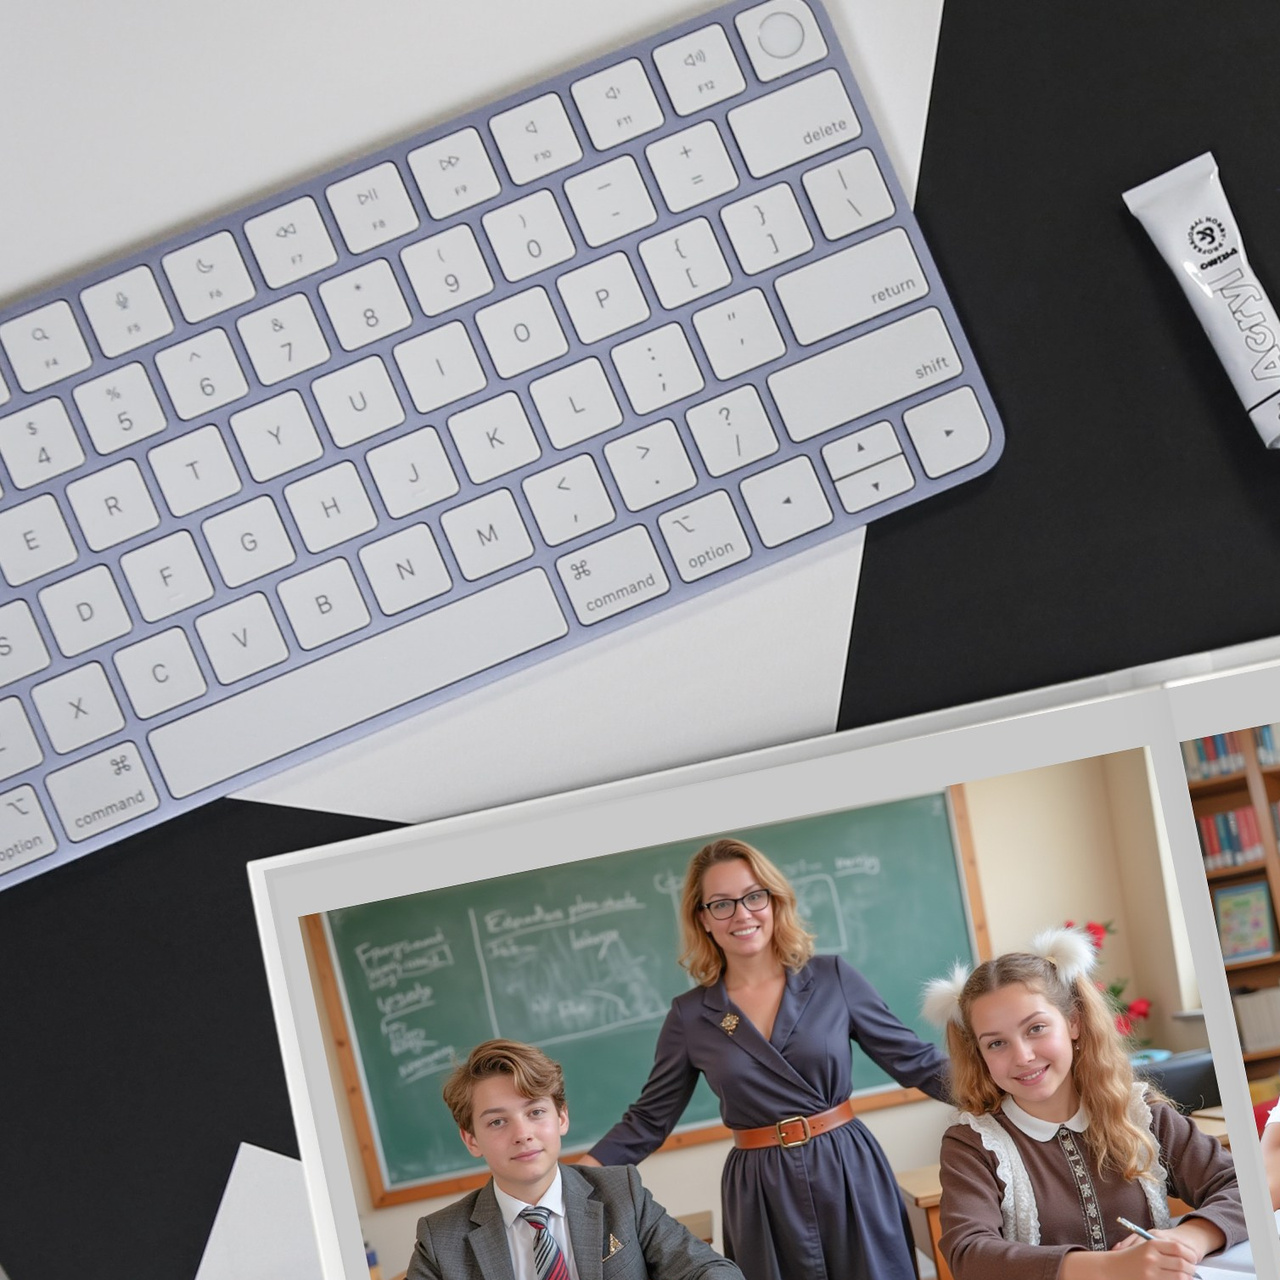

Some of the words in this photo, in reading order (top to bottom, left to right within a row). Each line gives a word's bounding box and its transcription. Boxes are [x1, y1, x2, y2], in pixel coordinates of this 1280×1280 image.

[698, 80, 715, 93] F12
[617, 115, 632, 128] F11
[803, 120, 846, 145] delete
[534, 150, 552, 162] F10
[455, 185, 467, 196] F9
[372, 219, 386, 230] F8
[526, 239, 542, 258] 0
[291, 254, 303, 265] F7
[444, 274, 460, 293] 9
[871, 279, 916, 303] return
[209, 289, 223, 299] F6
[595, 288, 610, 309] P
[363, 308, 379, 328] 8
[127, 323, 141, 334] F5
[513, 323, 530, 343] O
[280, 342, 292, 362] 7
[45, 358, 59, 368] F4
[916, 357, 949, 379] shift
[200, 377, 215, 396] 6
[348, 391, 367, 412] U
[568, 396, 586, 414] L
[117, 411, 133, 431] 5
[267, 425, 282, 445] Y
[486, 427, 505, 449] K
[38, 446, 52, 464] 4
[185, 460, 200, 480] T
[409, 463, 419, 483] J
[104, 496, 123, 516] R
[321, 497, 341, 518] H
[22, 530, 40, 551] E
[240, 532, 258, 552] G
[476, 523, 499, 547] M
[689, 543, 734, 568] option
[159, 566, 173, 587] F
[395, 558, 416, 580] N
[586, 574, 656, 612] command
[76, 602, 94, 622] D
[315, 594, 333, 615] B
[232, 627, 247, 648] V
[152, 663, 169, 683] C
[68, 697, 89, 719] X
[75, 789, 146, 829] command
